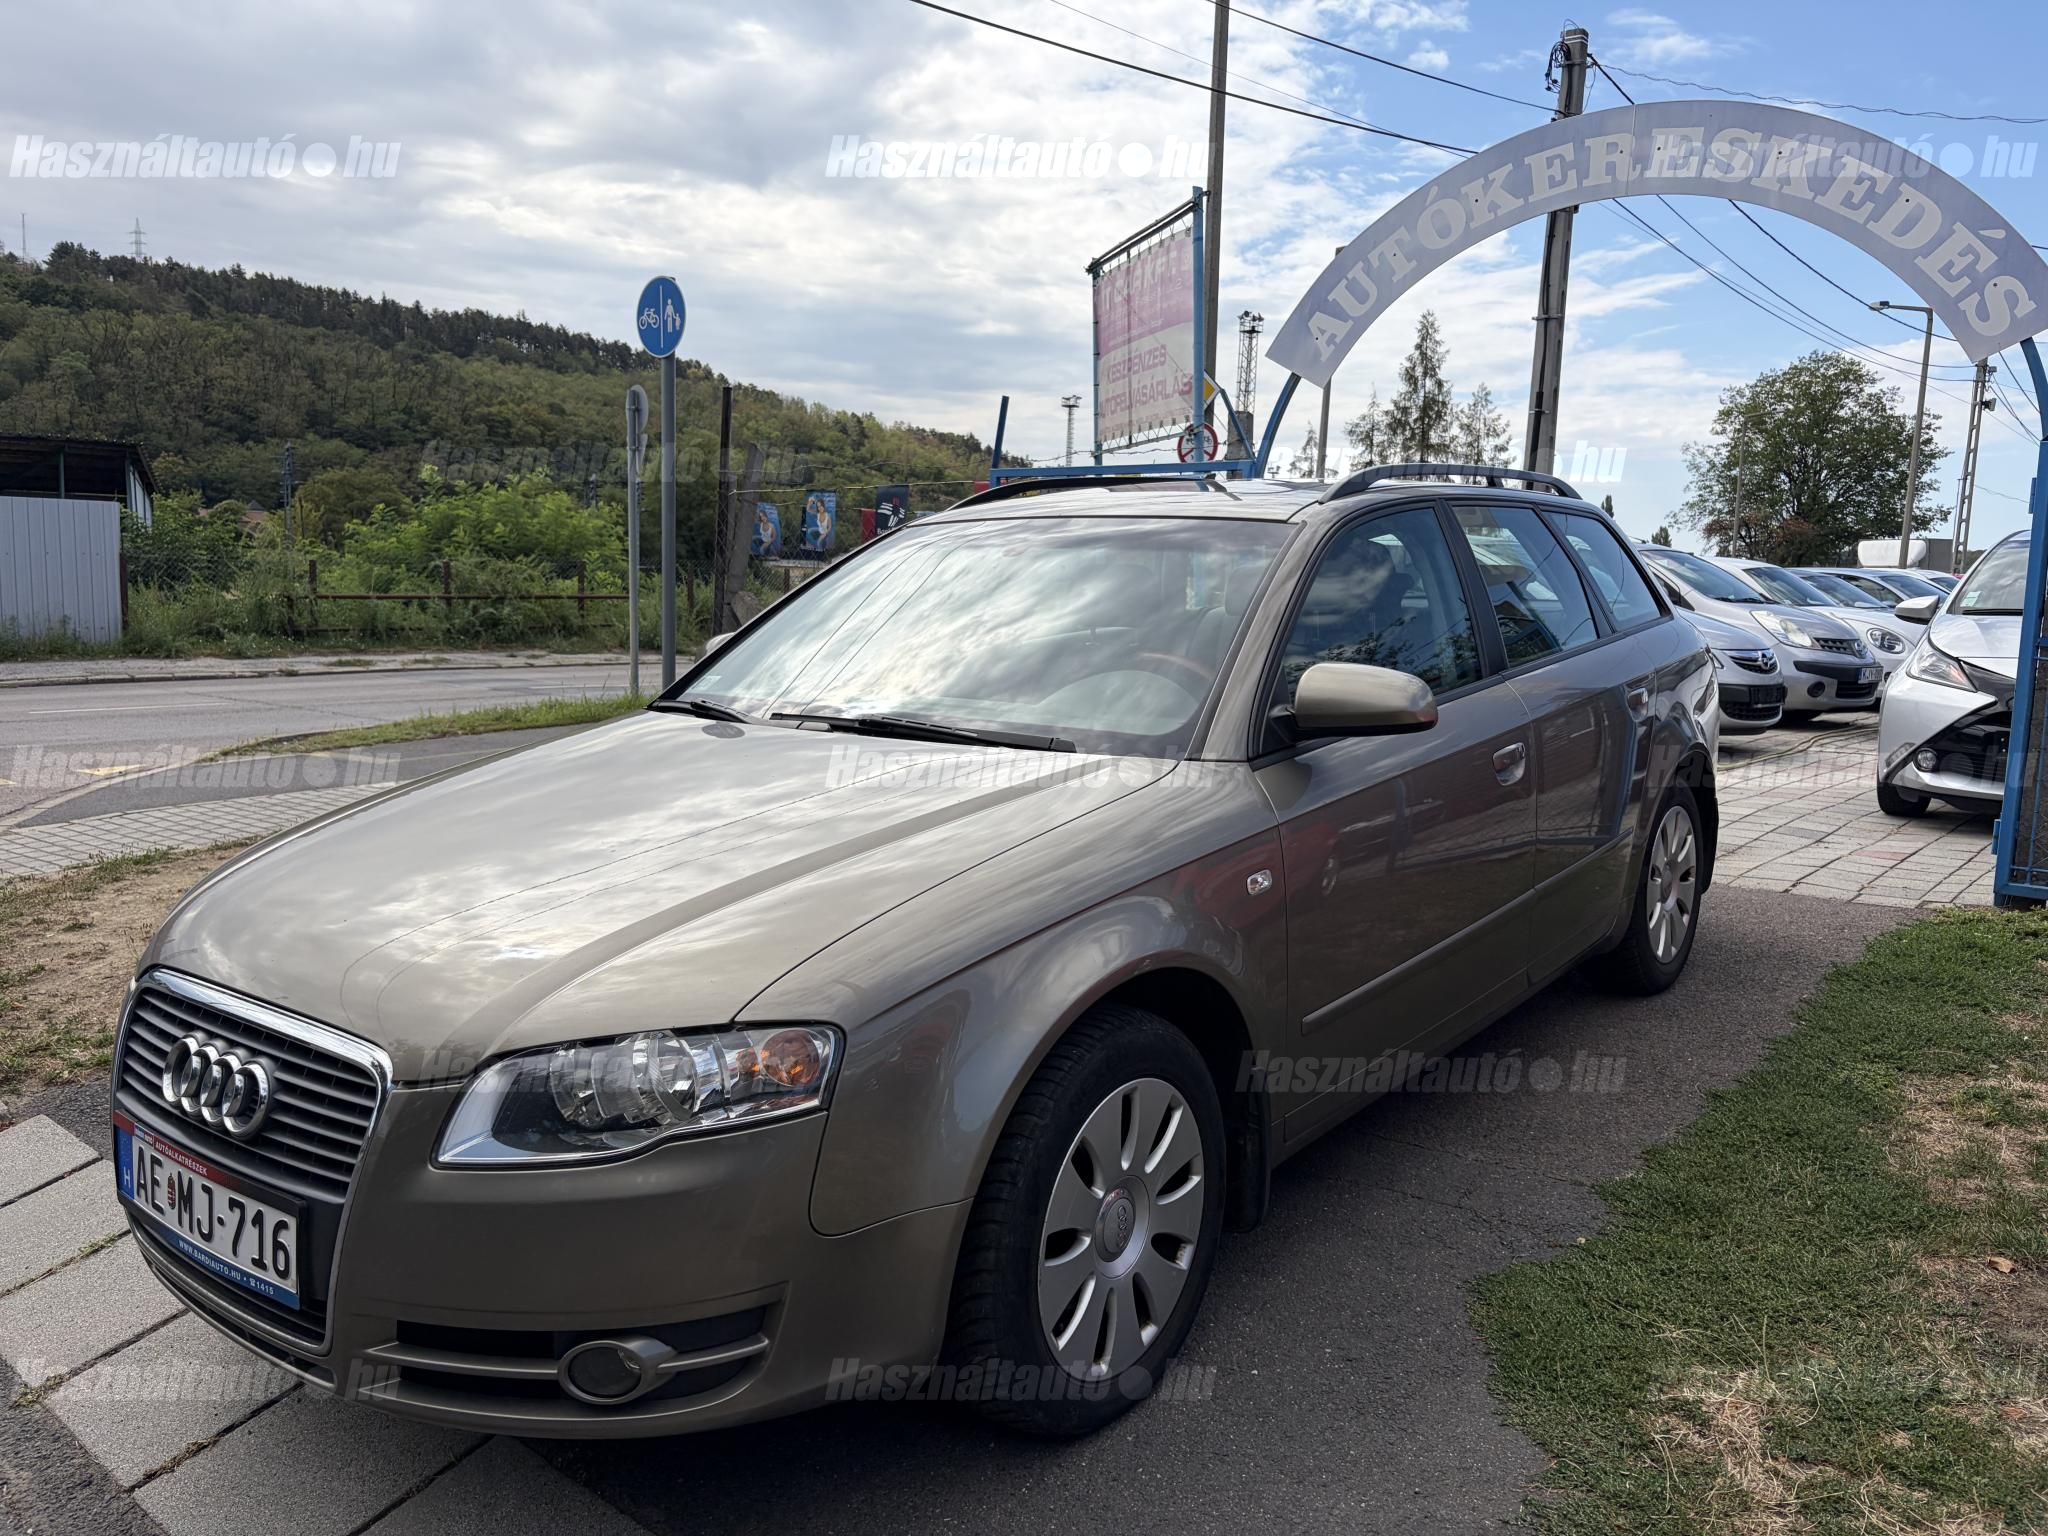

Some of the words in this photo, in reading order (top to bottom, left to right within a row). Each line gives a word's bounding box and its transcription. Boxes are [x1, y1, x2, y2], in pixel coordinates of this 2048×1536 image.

[1306, 126, 2036, 362] AUTÓKERESKEDÉS
[123, 1166, 131, 1189] H
[136, 1144, 165, 1216] AE
